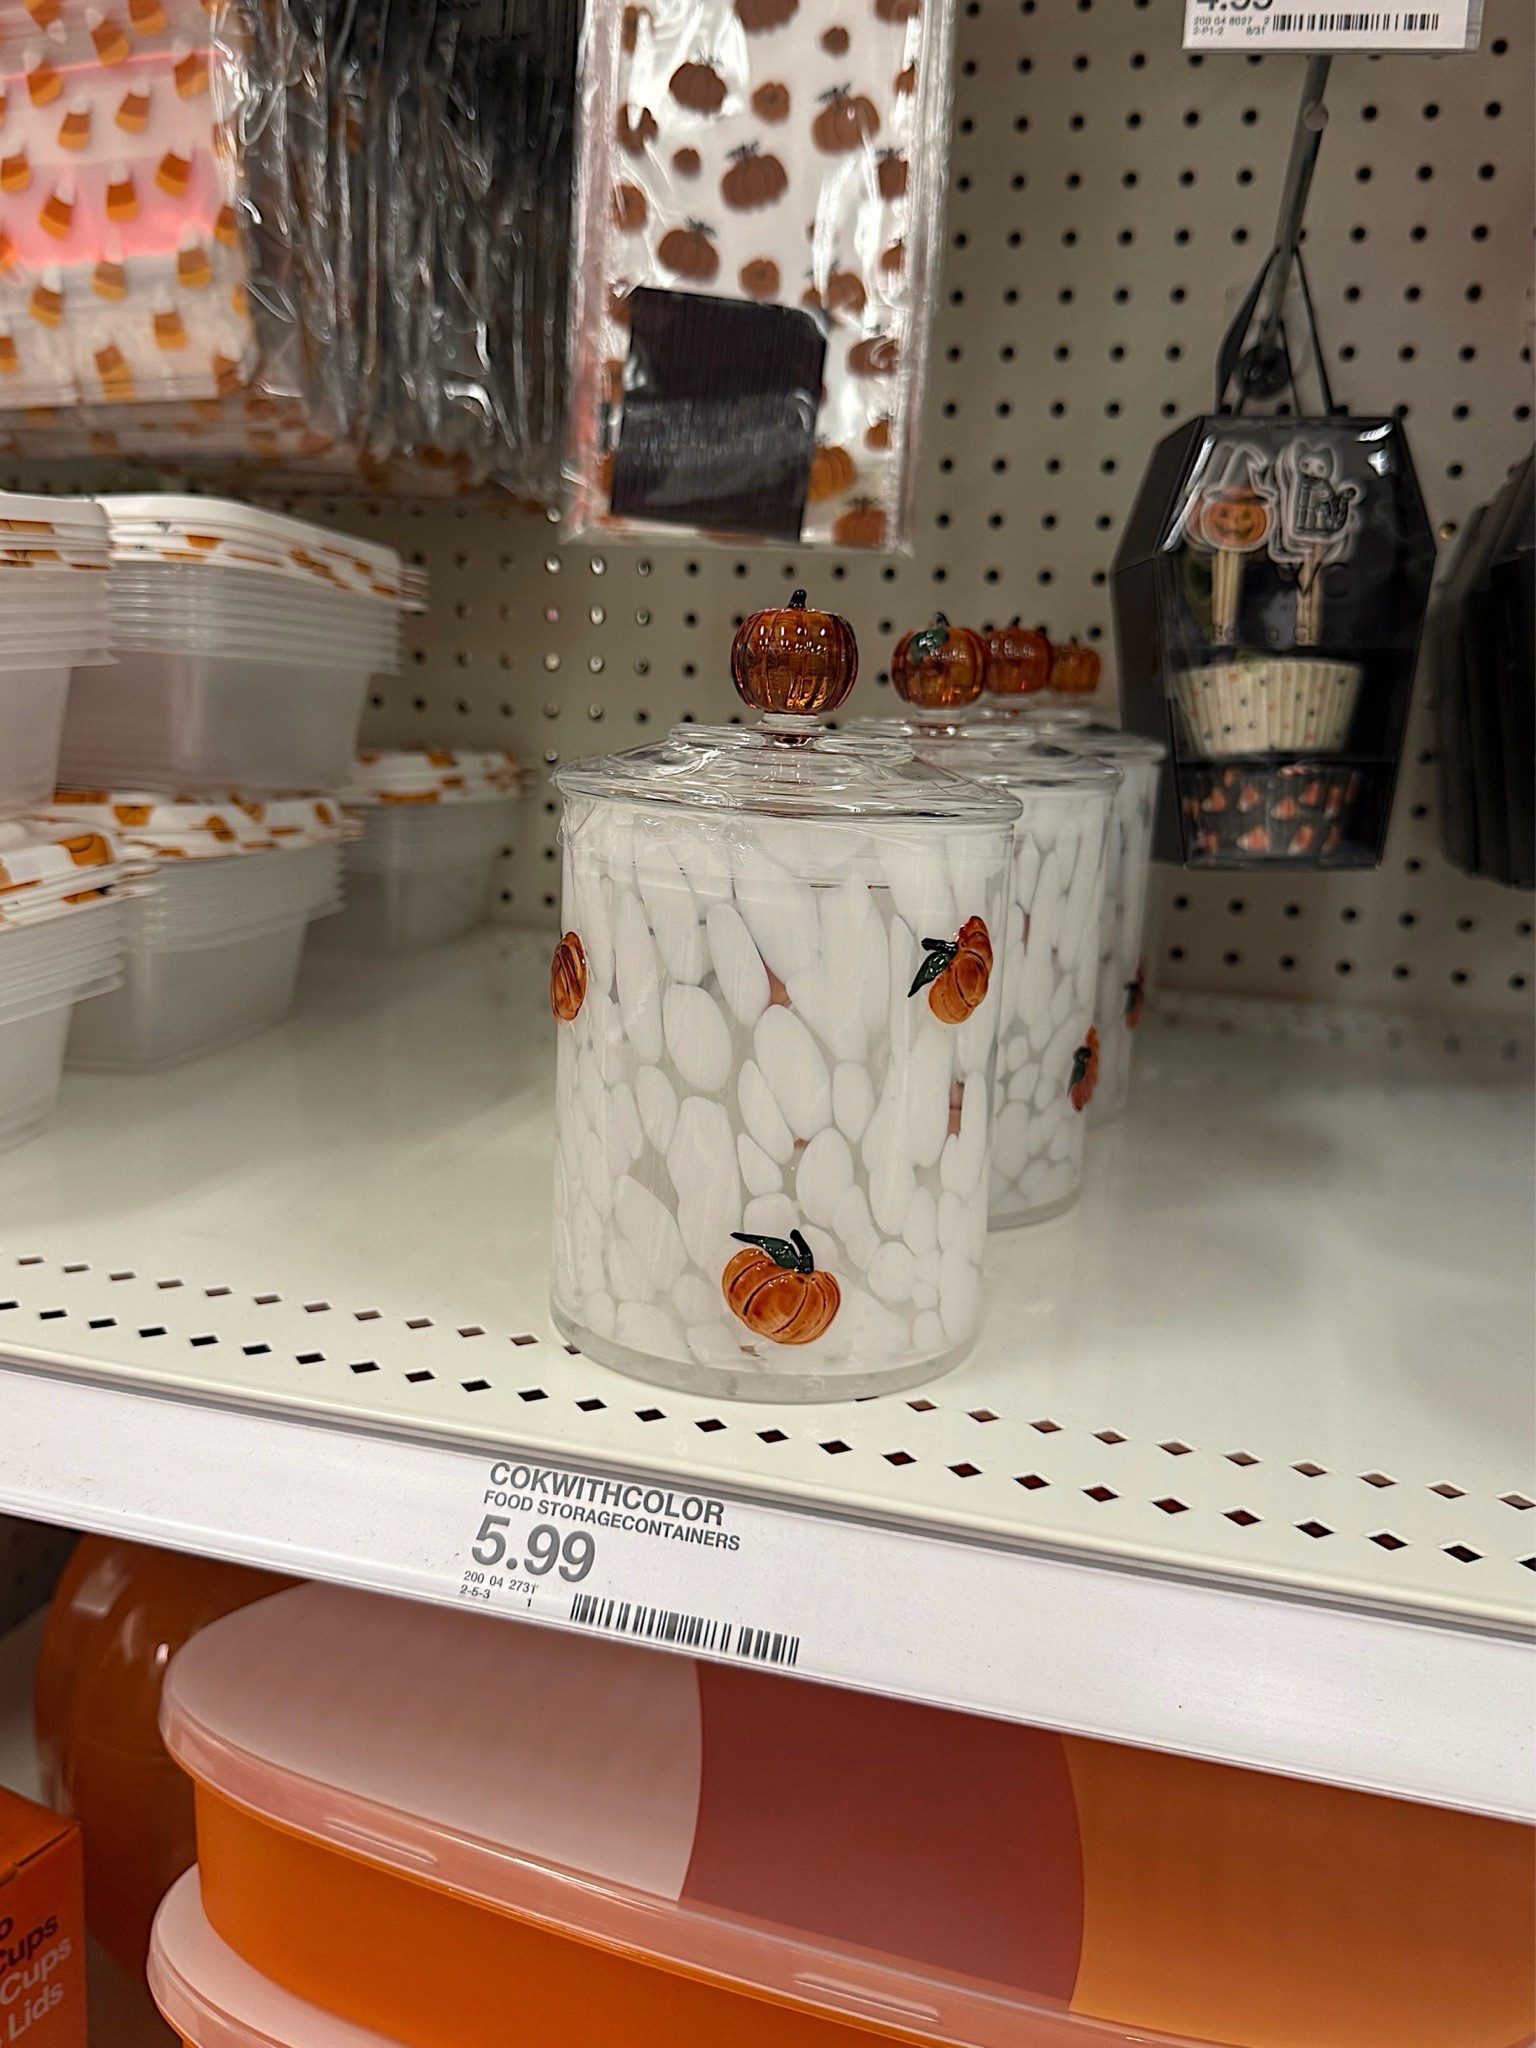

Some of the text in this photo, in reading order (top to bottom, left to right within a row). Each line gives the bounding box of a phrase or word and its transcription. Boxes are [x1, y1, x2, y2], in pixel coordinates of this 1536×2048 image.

[483, 1489, 741, 1551] FOOD STORAGECONTAINERS
[490, 1462, 725, 1526] COKWITHCOLOR
[472, 1514, 596, 1583] 5.99
[460, 1584, 491, 1600] 2-5-3
[463, 1570, 537, 1595] 200 04 2731
[0, 1936, 71, 2005] Cups
[8, 1982, 64, 2041] Lids
